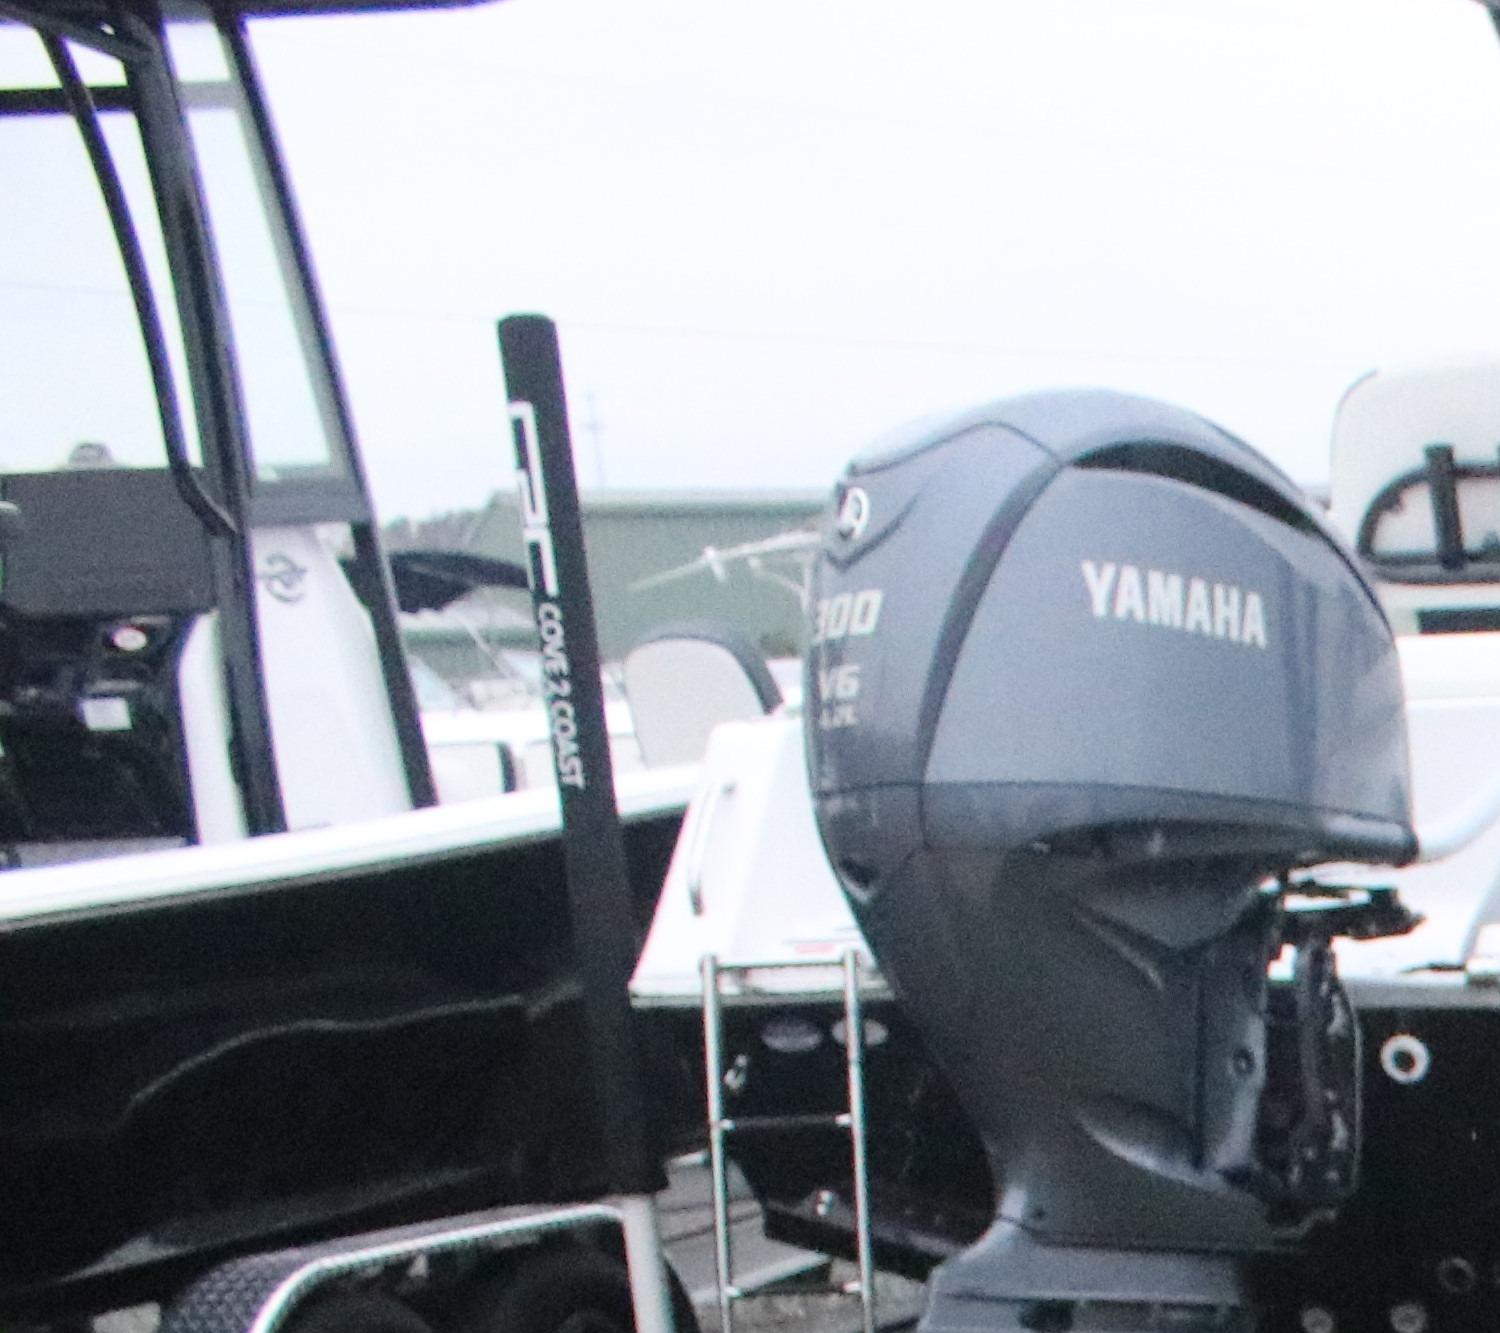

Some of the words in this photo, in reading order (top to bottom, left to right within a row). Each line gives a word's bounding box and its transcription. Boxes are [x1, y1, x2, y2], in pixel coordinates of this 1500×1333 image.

[538, 602, 571, 678] COVE
[1082, 559, 1267, 650] YAMAHA
[546, 678, 573, 698] 2
[552, 700, 587, 790] COAST
